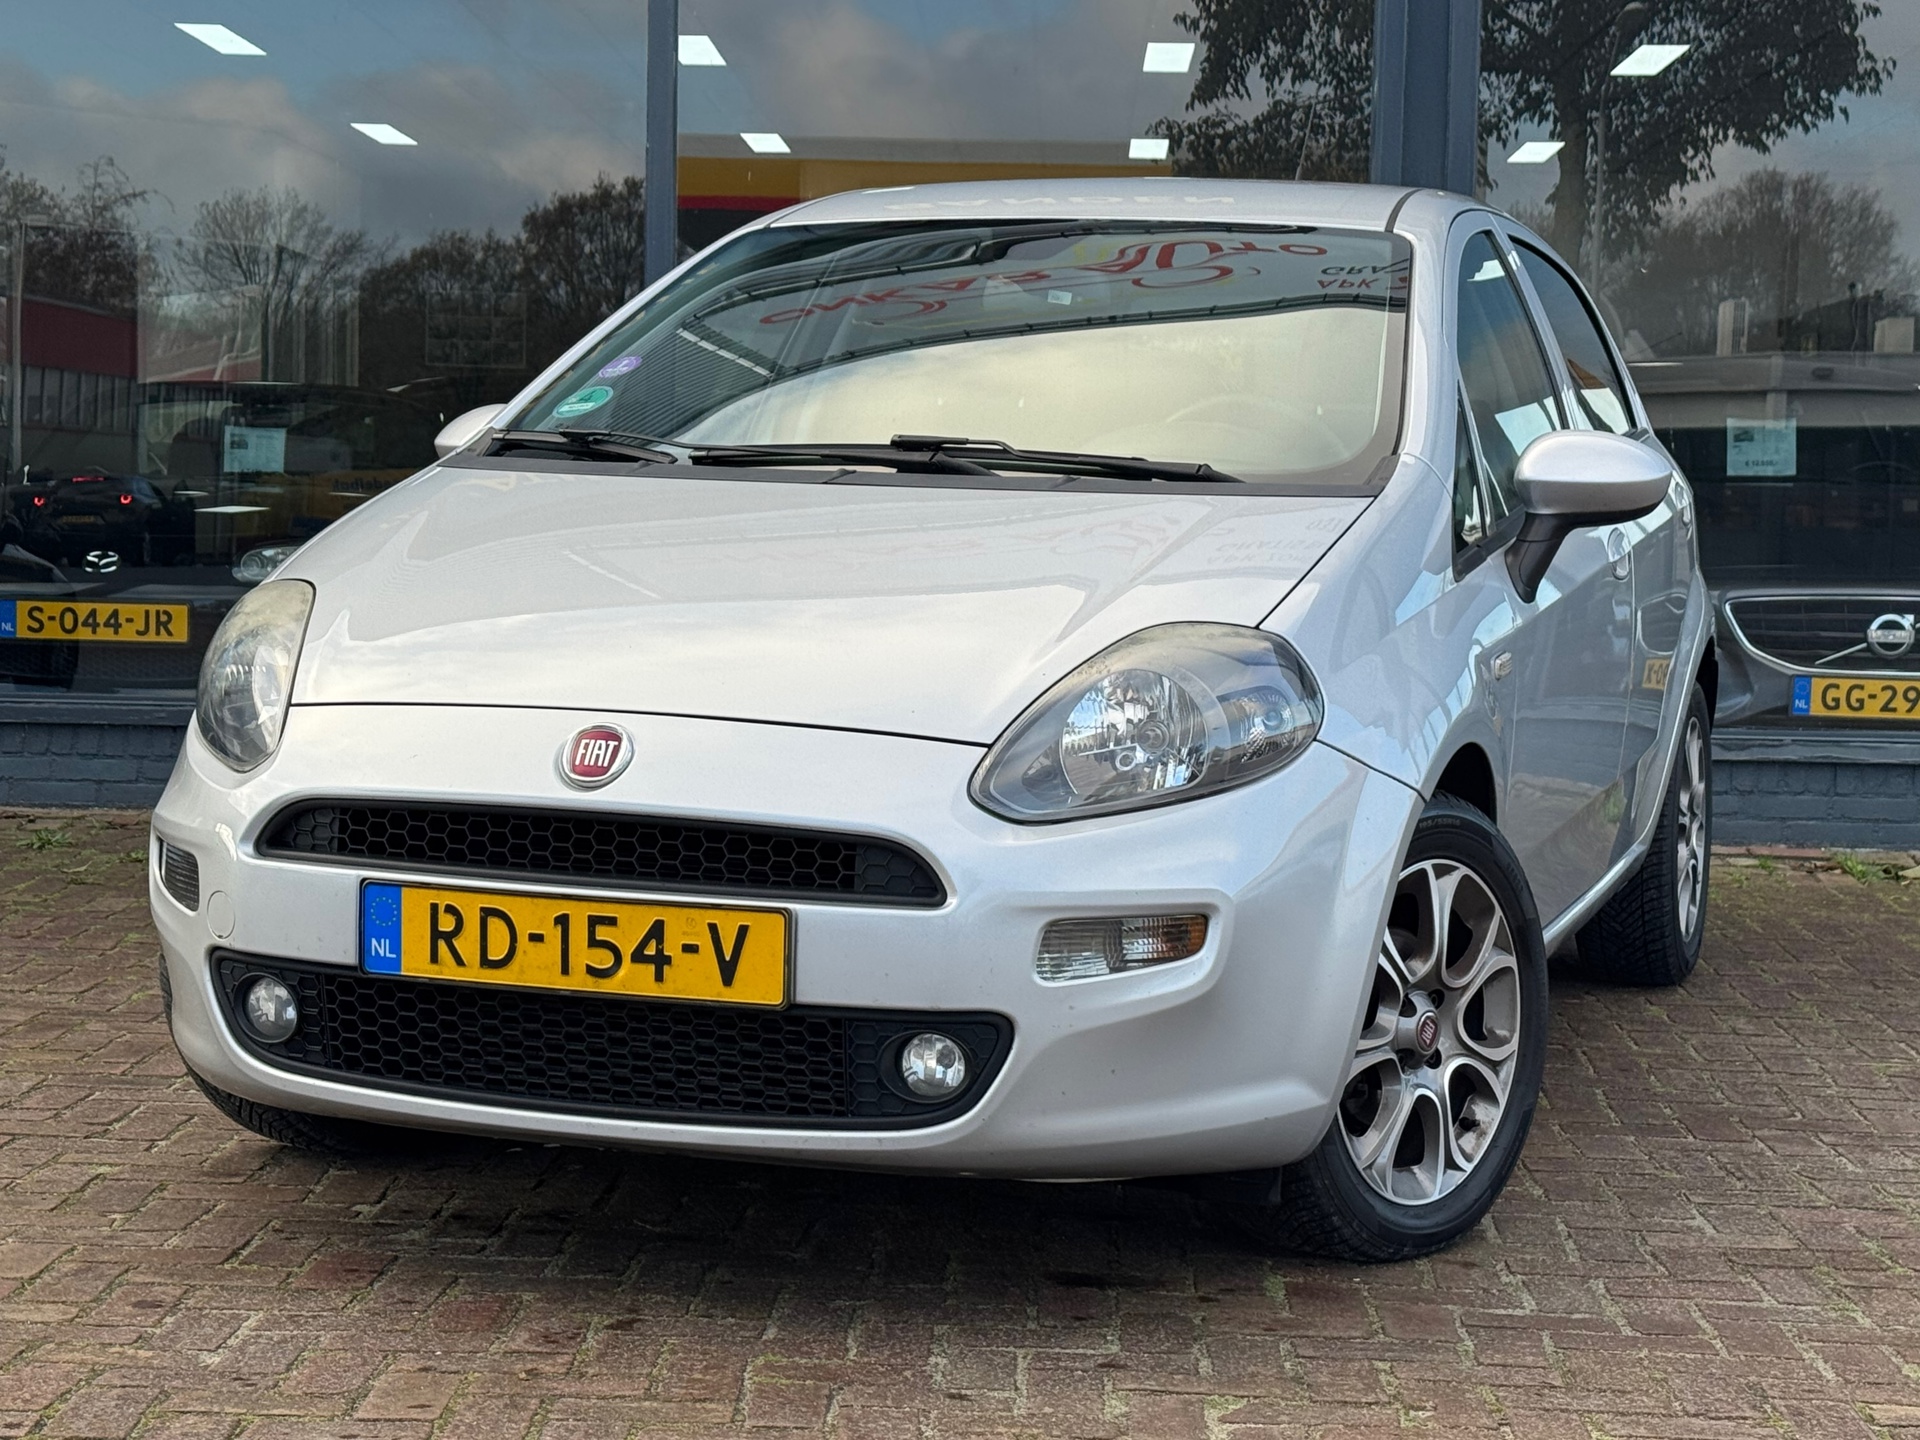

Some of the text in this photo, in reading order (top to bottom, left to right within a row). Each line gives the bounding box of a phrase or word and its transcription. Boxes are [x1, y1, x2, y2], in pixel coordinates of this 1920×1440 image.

[1, 622, 15, 632] NL
[26, 605, 174, 637] S-044-JR
[1794, 699, 1808, 709] NL
[1820, 682, 1920, 713] GG-29
[574, 738, 619, 768] FIAT
[370, 937, 397, 959] NL
[428, 900, 750, 988] RD-154-V
[1420, 1019, 1436, 1047] FIAT
